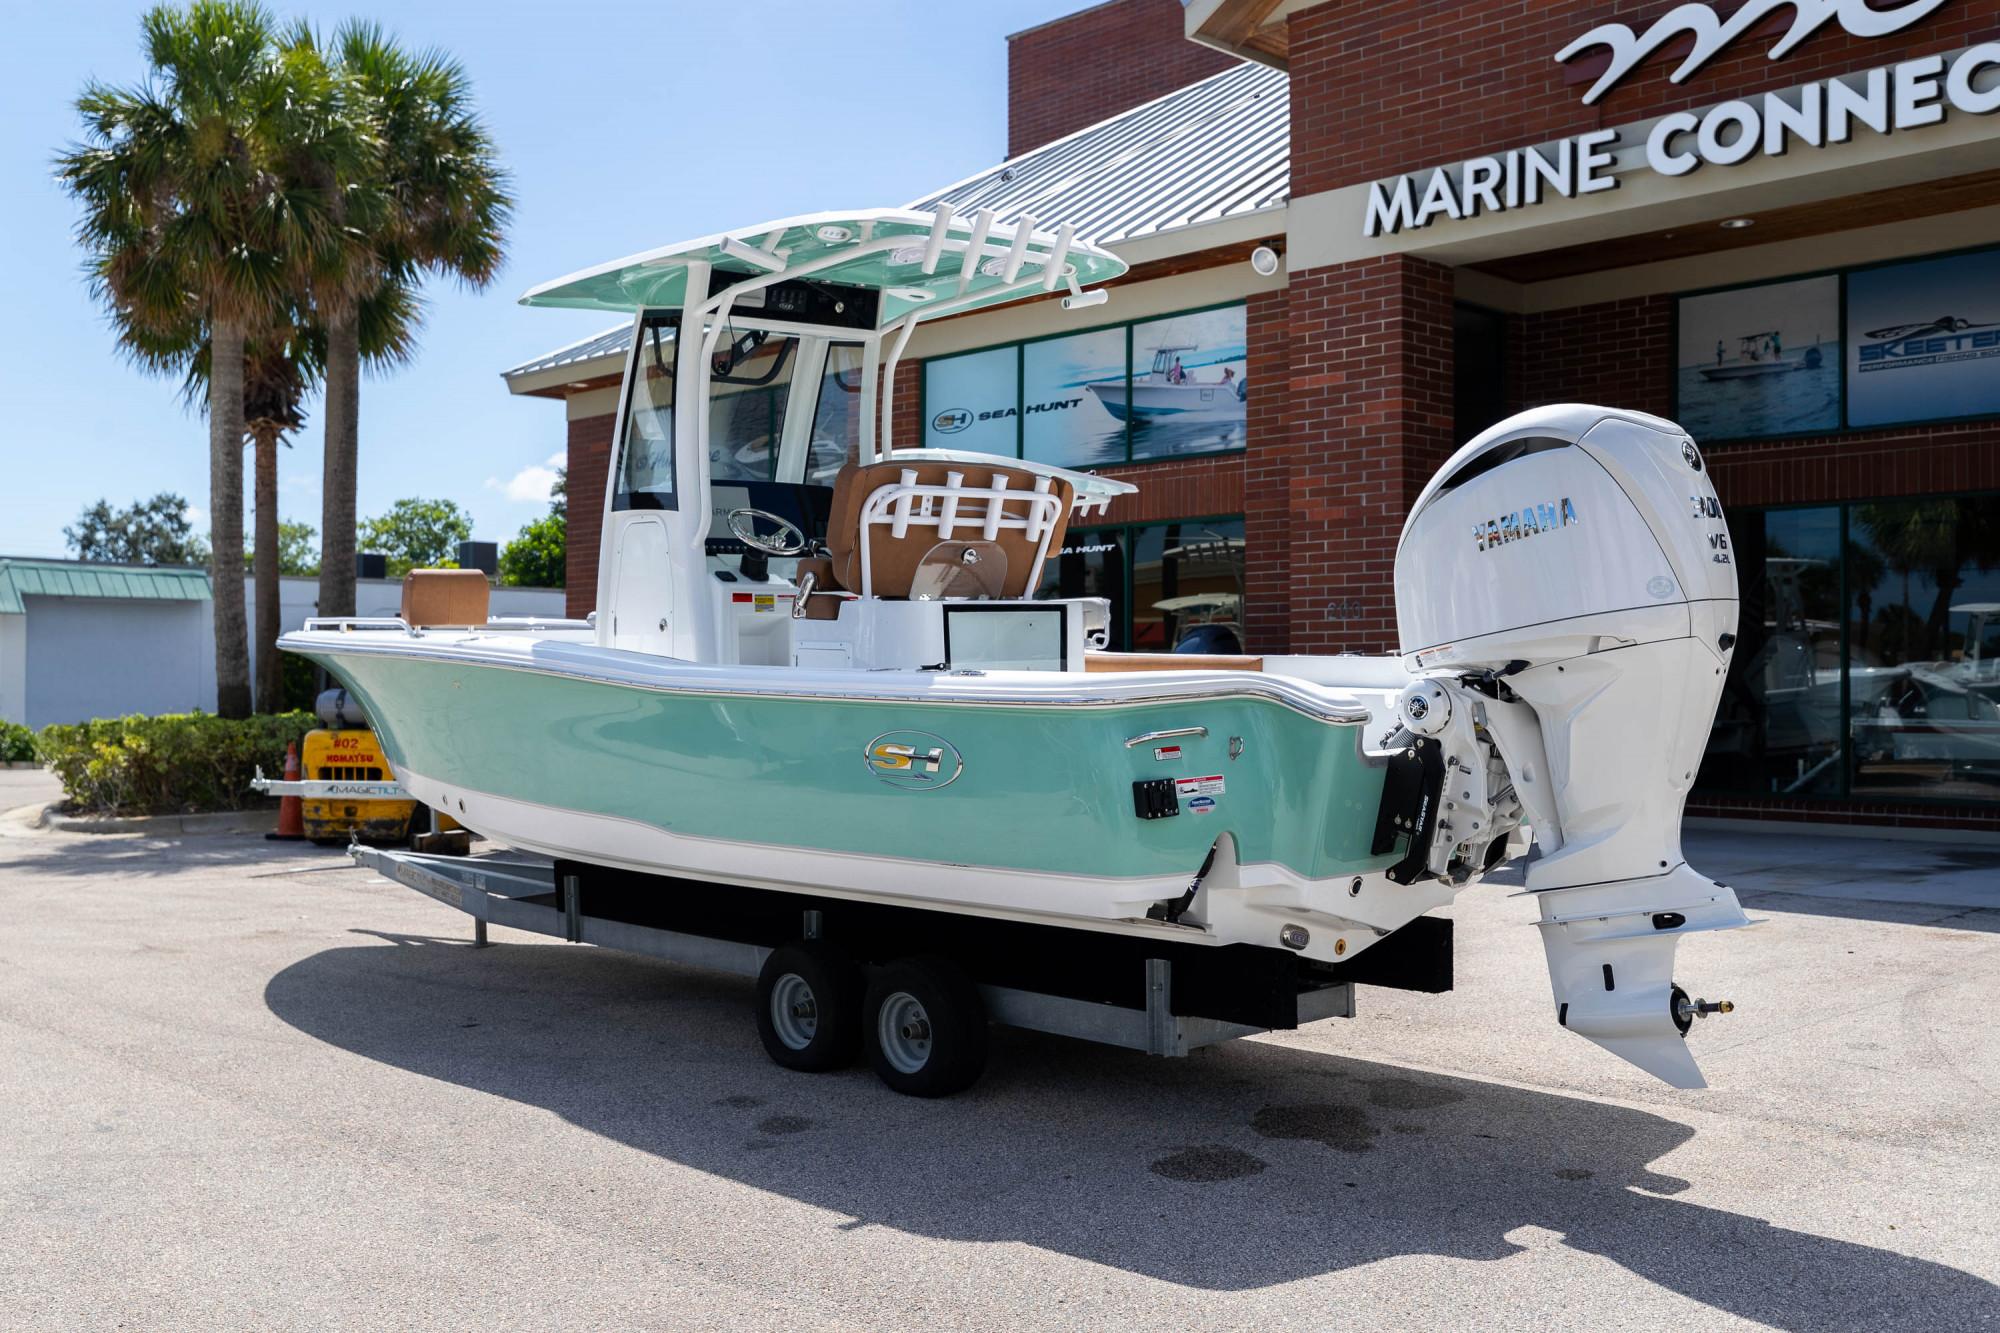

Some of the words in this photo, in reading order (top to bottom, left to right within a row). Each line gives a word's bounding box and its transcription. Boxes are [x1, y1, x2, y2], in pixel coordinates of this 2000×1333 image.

[1363, 128, 1618, 237] MARINE
[1646, 42, 2000, 176] CONNEC
[1859, 330, 2000, 361] SKEETE
[979, 407, 1018, 421] SEA
[1026, 399, 1083, 414] HUNT
[1472, 498, 1578, 552] YAMAHA
[1076, 544, 1116, 553] HUNT
[1707, 533, 1728, 549] V6
[334, 738, 359, 749] #02
[326, 754, 374, 763] KOMATSU
